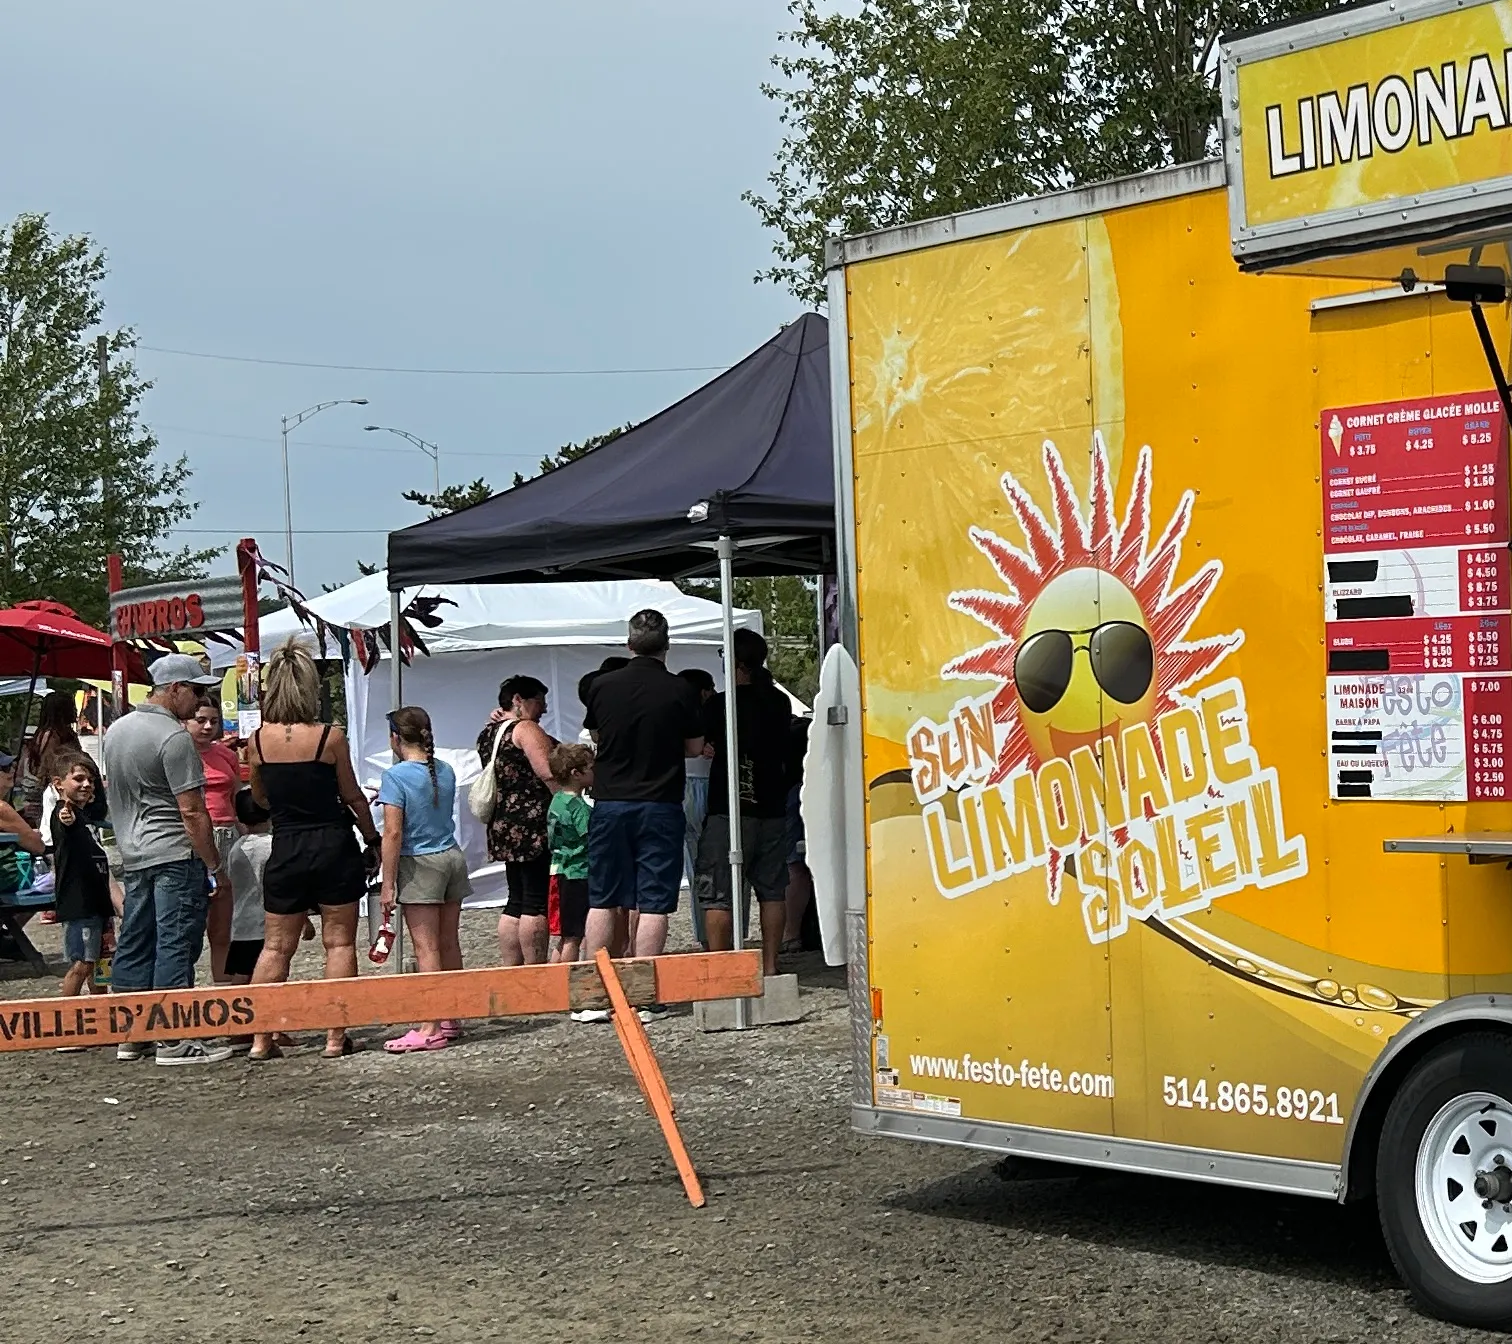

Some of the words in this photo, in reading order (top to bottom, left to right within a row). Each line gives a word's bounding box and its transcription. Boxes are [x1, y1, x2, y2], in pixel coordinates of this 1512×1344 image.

[1346, 414, 1385, 429] CORNET
[1386, 408, 1421, 423] CRÈME
[1423, 403, 1462, 421] GLACÉE
[1464, 401, 1500, 416] MOLLE
[1357, 444, 1376, 456] 3.75
[1413, 438, 1434, 450] 4.25
[1464, 464, 1470, 476] $
[1473, 463, 1495, 475] 1.25
[1464, 477, 1470, 488] $
[1473, 475, 1495, 487] 1.50
[1465, 501, 1471, 512] $
[1465, 524, 1471, 535] $
[1474, 522, 1495, 535] 5.50
[1467, 553, 1473, 565] $
[1475, 552, 1497, 563] 4.50
[1467, 567, 1473, 579] $
[1475, 566, 1497, 578] 4.50
[1467, 582, 1474, 593] $
[1476, 581, 1498, 592] 8.75
[1468, 596, 1474, 608] $
[1476, 595, 1498, 607] 3.75
[114, 593, 206, 638] CHURROS
[1423, 634, 1429, 645] $
[1431, 633, 1452, 644] 4.25
[1468, 631, 1475, 642] $
[1477, 631, 1499, 642] 5.50
[1424, 646, 1430, 657] $
[1432, 645, 1452, 656] 5.50
[1468, 643, 1475, 654] $
[1477, 643, 1499, 654] 6.75
[1424, 657, 1430, 669] $
[1432, 657, 1453, 668] 6.25
[1469, 656, 1475, 667] $
[1477, 655, 1499, 666] 7.25
[1333, 683, 1386, 695] LIMONADE
[1471, 681, 1477, 692] $
[1479, 681, 1500, 692] 7.00
[1340, 697, 1379, 709] MAISON
[1363, 718, 1381, 726] PAPA
[1472, 714, 1478, 725] $
[1480, 714, 1502, 725] 6.00
[1473, 729, 1479, 740] $
[1481, 728, 1503, 739] 4.75
[911, 701, 999, 794] SUN
[1473, 743, 1480, 754] $
[1482, 743, 1503, 754] 5.75
[1474, 758, 1480, 768] $
[1482, 757, 1504, 768] 3.00
[1474, 772, 1481, 783] $
[1482, 772, 1504, 783] 2.50
[925, 689, 1254, 891] LIMONADE
[1475, 786, 1481, 797] $
[1483, 786, 1505, 796] 4.00
[1078, 781, 1302, 935] SOLEIL
[0, 1007, 98, 1041] VILLE
[109, 996, 255, 1034] D'AMOS
[909, 1053, 1114, 1099] www.festo-fete.com
[1162, 1075, 1345, 1124] 514.865.8921
